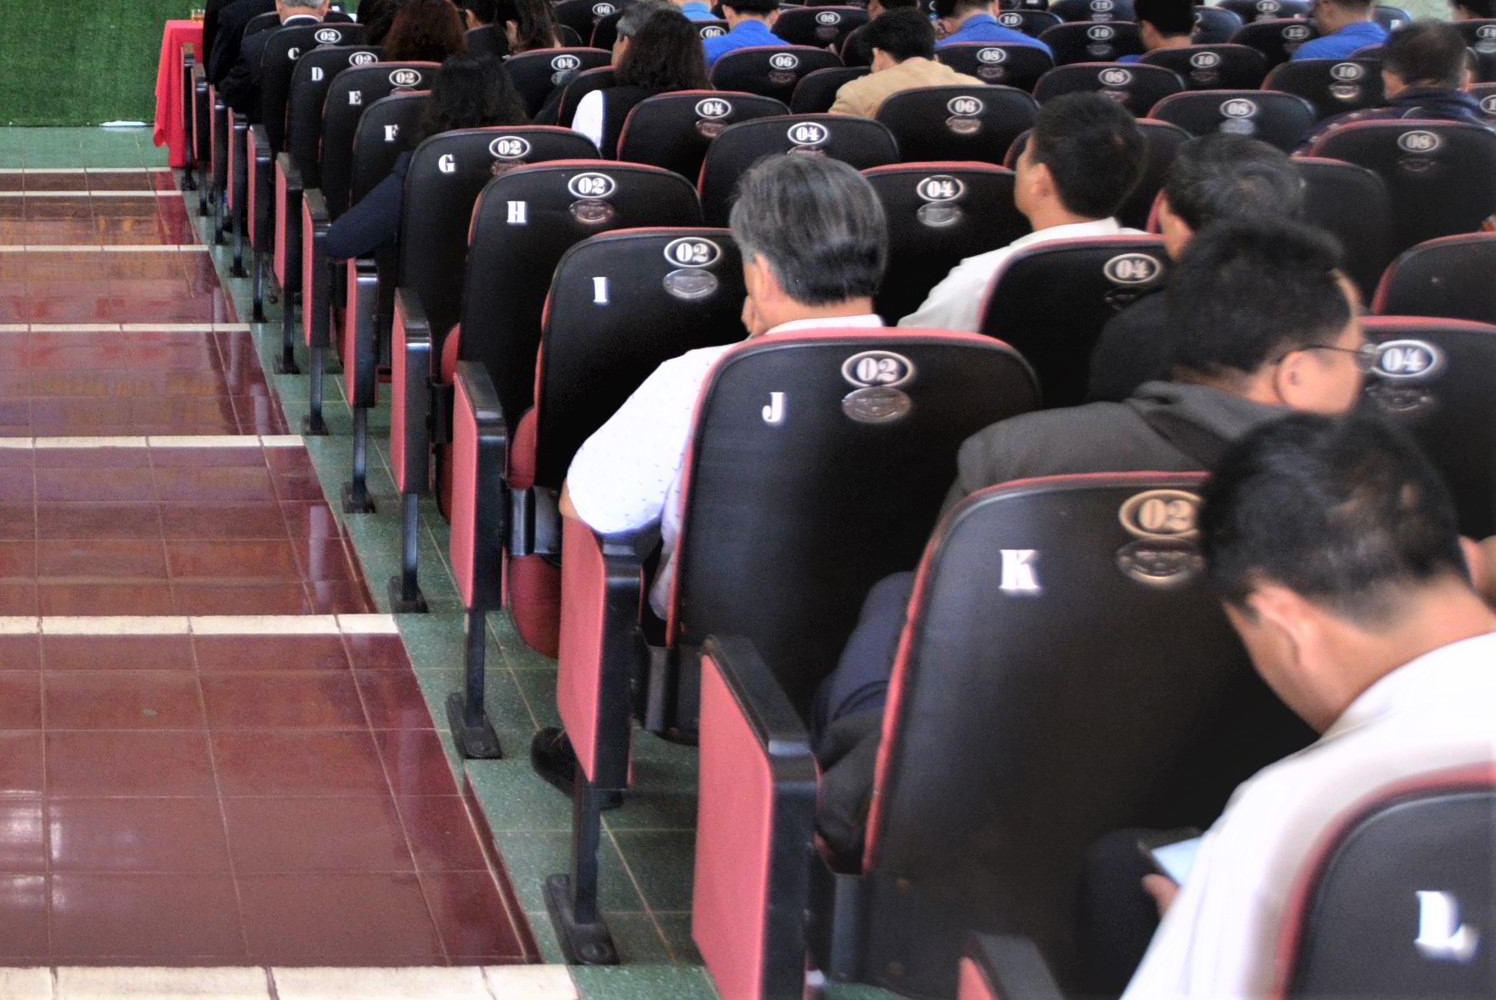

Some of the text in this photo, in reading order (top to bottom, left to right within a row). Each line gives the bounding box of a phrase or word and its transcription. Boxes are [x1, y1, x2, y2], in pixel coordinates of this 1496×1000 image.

[776, 56, 793, 68] 06
[349, 90, 362, 105] E
[796, 126, 819, 142] 04
[498, 139, 522, 156] 02
[438, 153, 457, 174] G
[578, 177, 604, 195] 02
[927, 180, 954, 198] 04
[507, 200, 528, 225] H
[676, 242, 709, 264] 02
[1115, 258, 1150, 281] 04
[593, 276, 608, 304] I
[856, 356, 896, 383] 02
[1381, 347, 1422, 372] 04
[762, 392, 786, 425] J
[998, 548, 1041, 594] K
[1415, 889, 1480, 962] L
